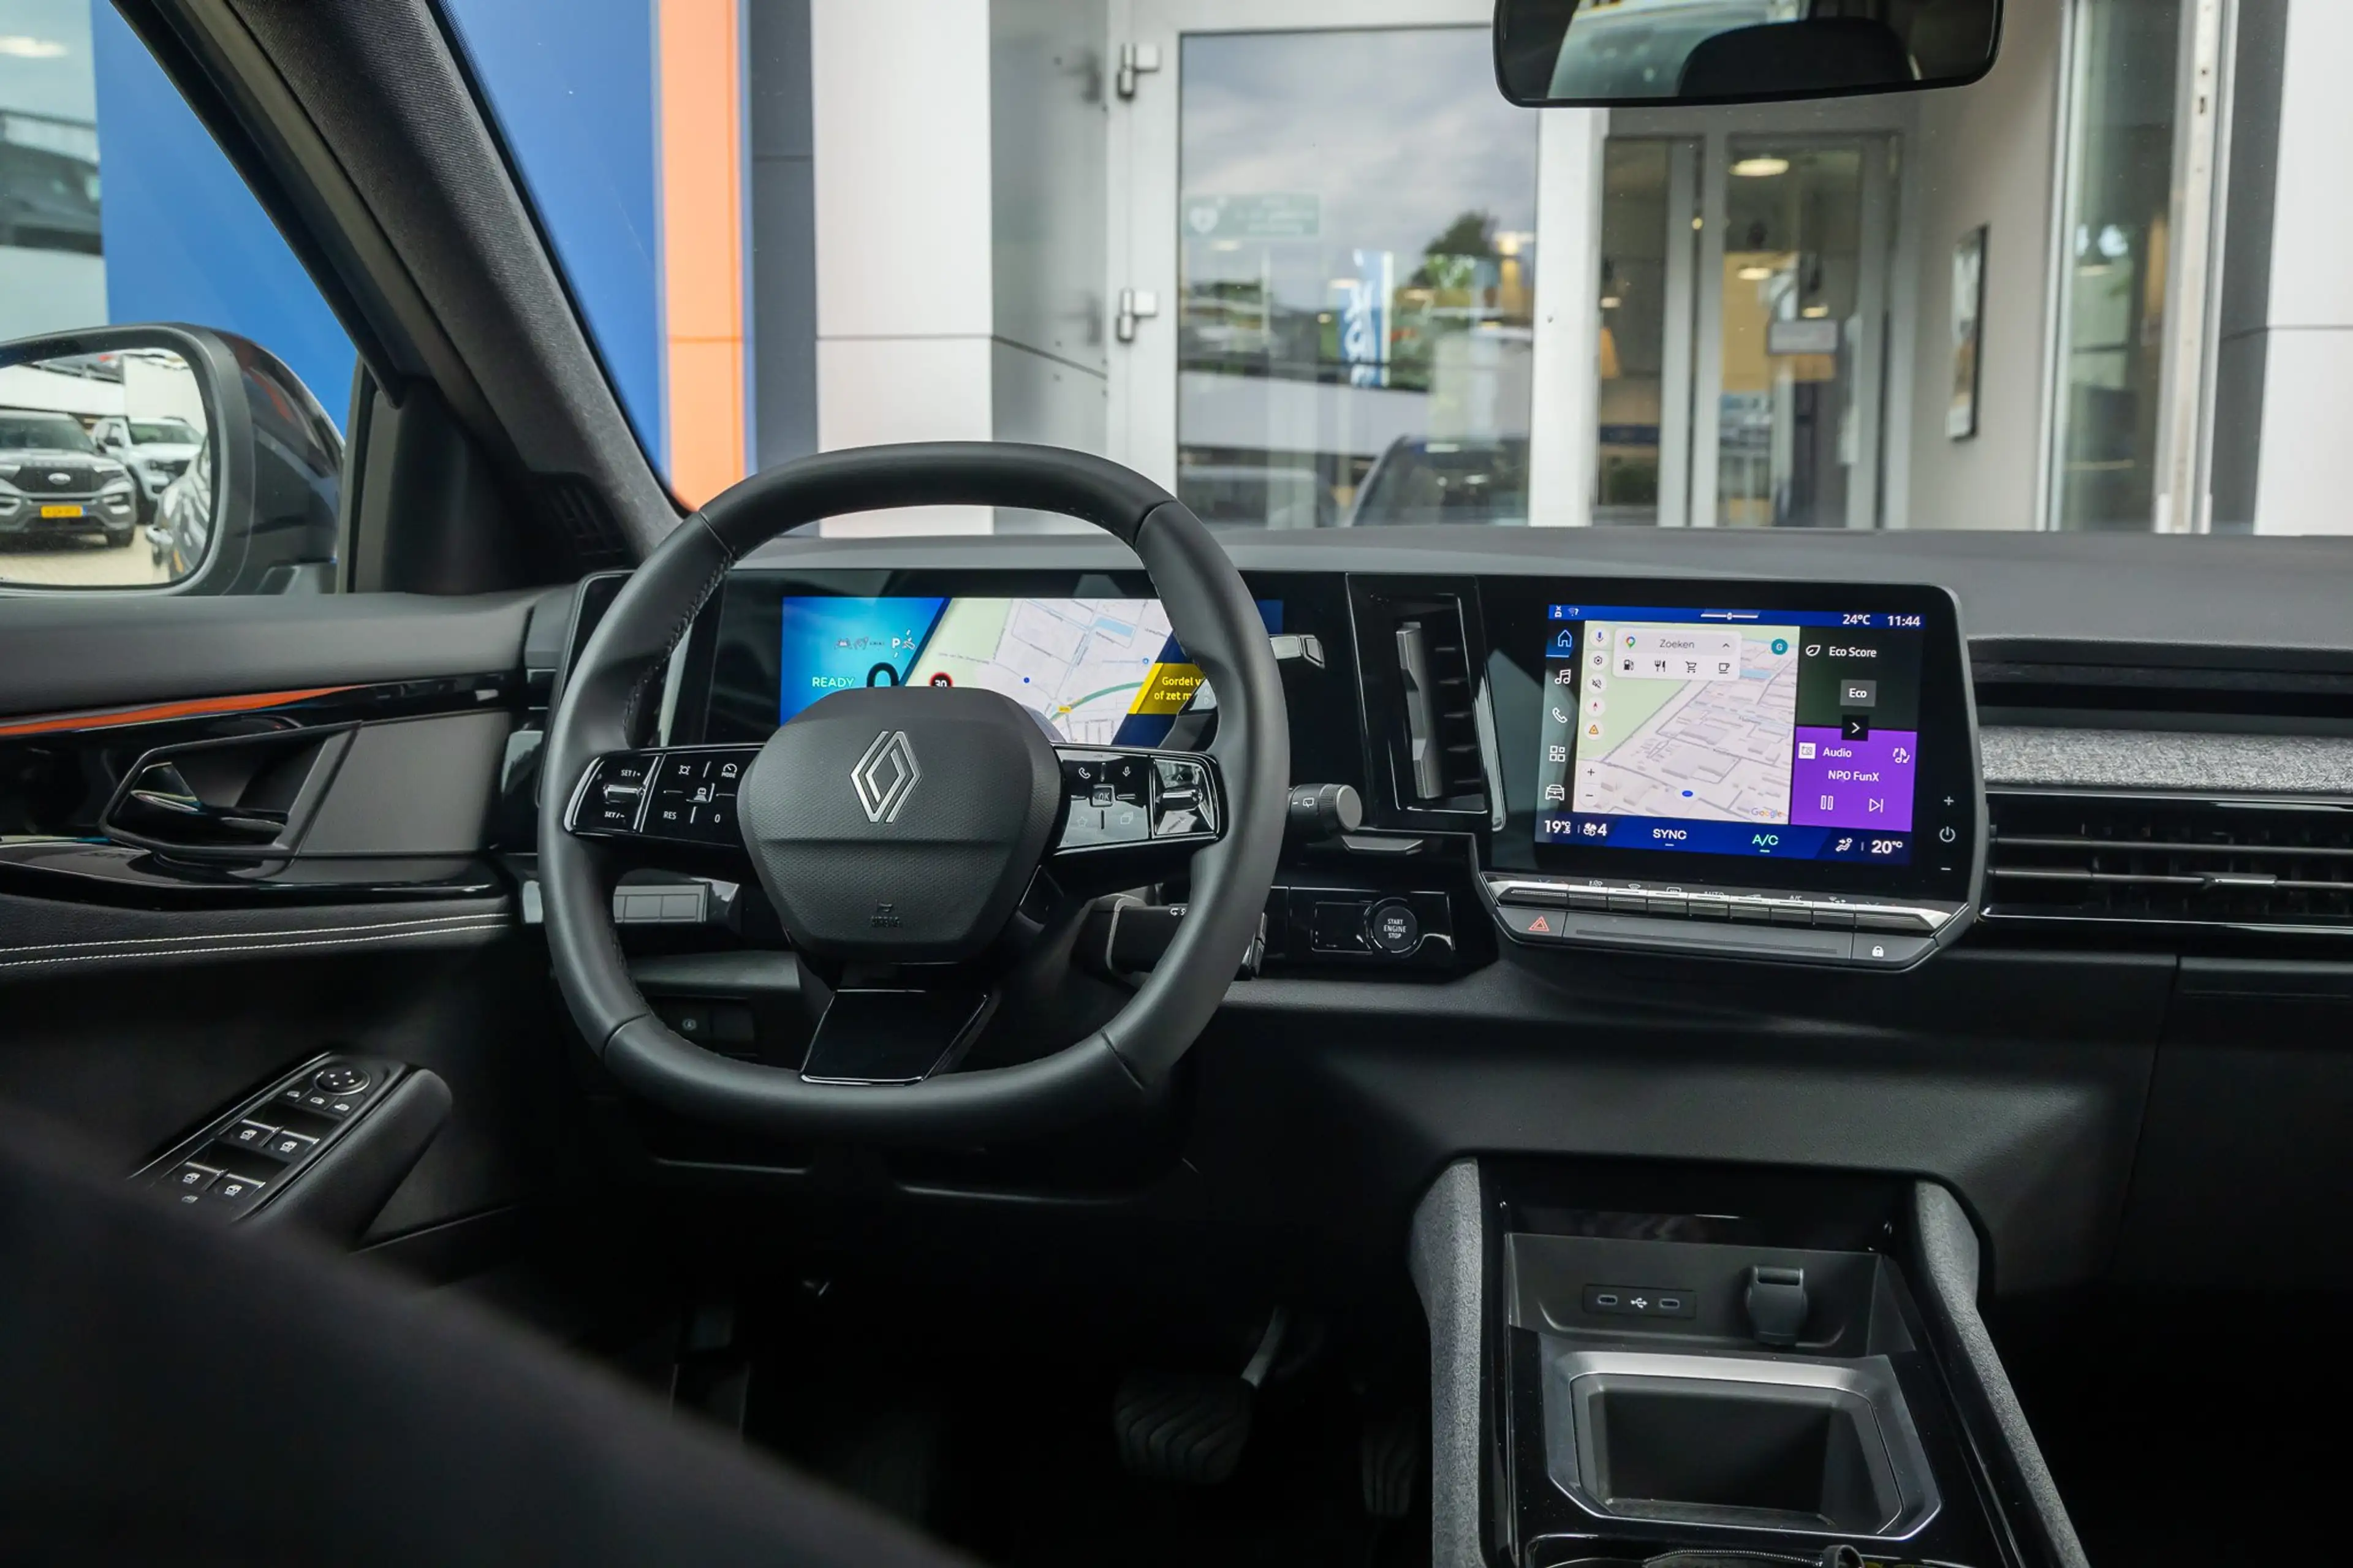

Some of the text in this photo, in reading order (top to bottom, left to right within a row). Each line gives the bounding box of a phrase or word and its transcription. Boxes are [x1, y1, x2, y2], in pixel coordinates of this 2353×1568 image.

[1842, 614, 1871, 625] 24°C
[1887, 616, 1921, 626] 11:44
[1660, 639, 1695, 649] Zoeken
[1828, 646, 1877, 657] Eco Score
[812, 676, 855, 687] READY
[1161, 676, 1194, 686] Gordel
[1154, 690, 1165, 700] of
[1165, 691, 1181, 700] zet
[1848, 687, 1868, 698] Eco
[1822, 748, 1852, 758] Audio
[1828, 770, 1879, 782] NPO FunX
[663, 811, 677, 820] RES
[1751, 807, 1782, 819] Google
[1597, 823, 1607, 836] 4
[1653, 828, 1688, 840] SYNC
[1752, 834, 1779, 846] A/C
